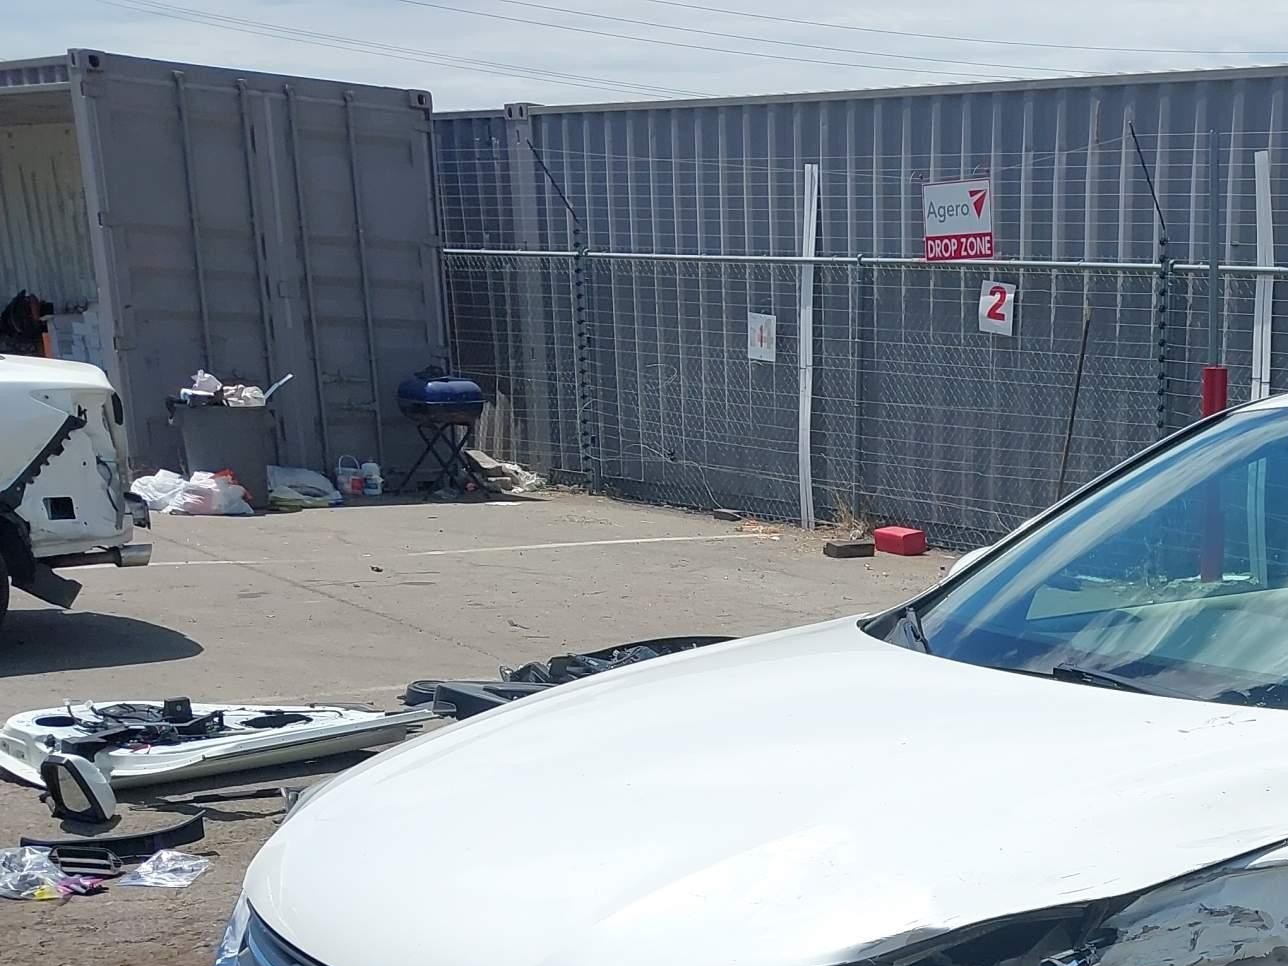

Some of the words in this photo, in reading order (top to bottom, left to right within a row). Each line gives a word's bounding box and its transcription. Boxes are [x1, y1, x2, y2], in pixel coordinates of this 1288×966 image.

[927, 200, 969, 223] Agero
[927, 238, 958, 258] DROP
[960, 235, 991, 256] ZONE
[986, 285, 1007, 321] 2
